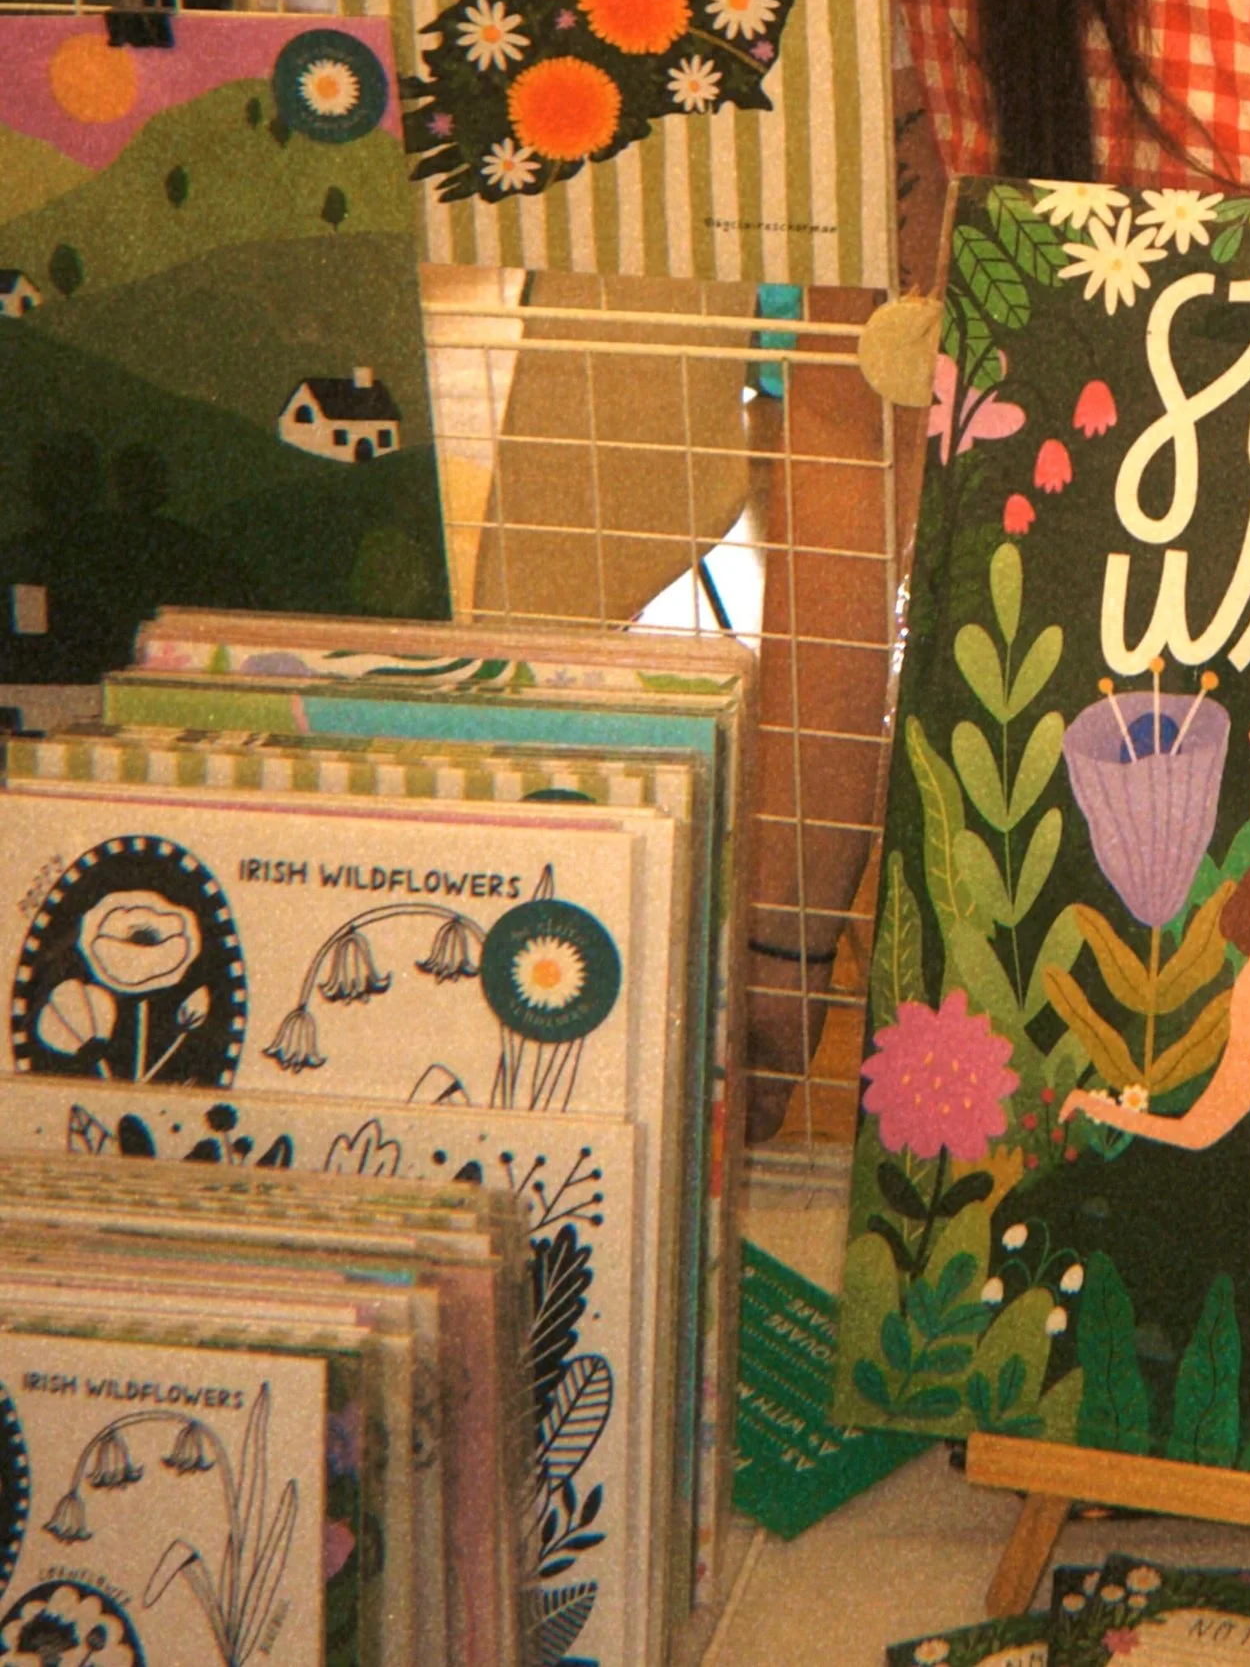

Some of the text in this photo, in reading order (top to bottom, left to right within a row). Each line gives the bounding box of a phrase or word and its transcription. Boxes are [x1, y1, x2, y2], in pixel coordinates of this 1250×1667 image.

[238, 858, 521, 899] IRISH WILDFLOWERS
[22, 1371, 246, 1410] IRISH WILDFLOWERS
